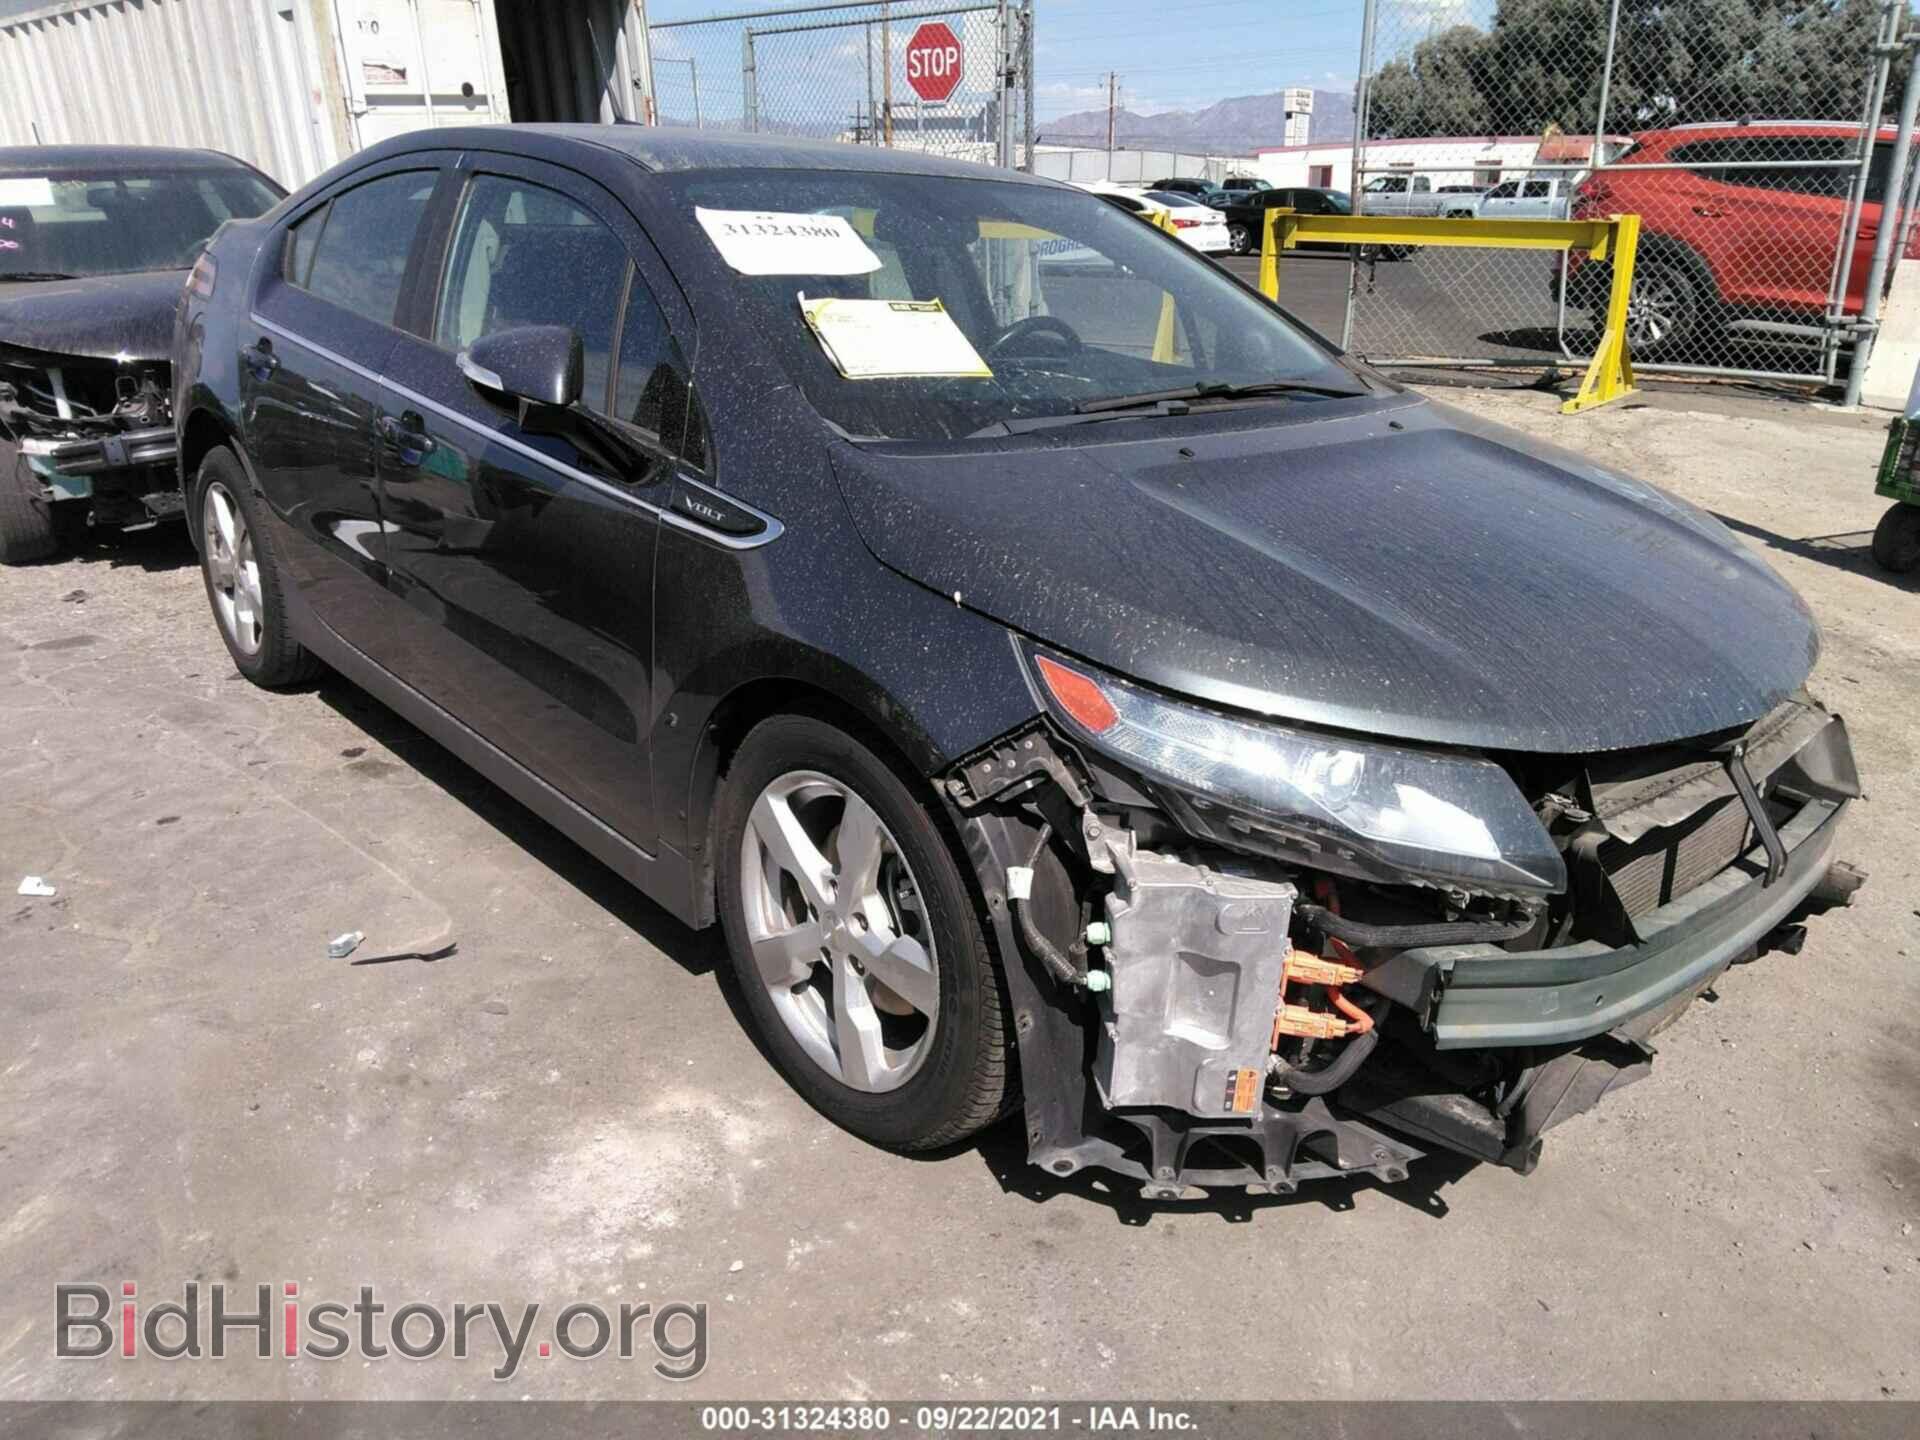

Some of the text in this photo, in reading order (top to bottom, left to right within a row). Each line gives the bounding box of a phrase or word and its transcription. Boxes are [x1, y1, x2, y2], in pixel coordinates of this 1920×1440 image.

[909, 46, 958, 78] STOP
[723, 223, 840, 238] 31324380
[686, 495, 726, 521] VOLT
